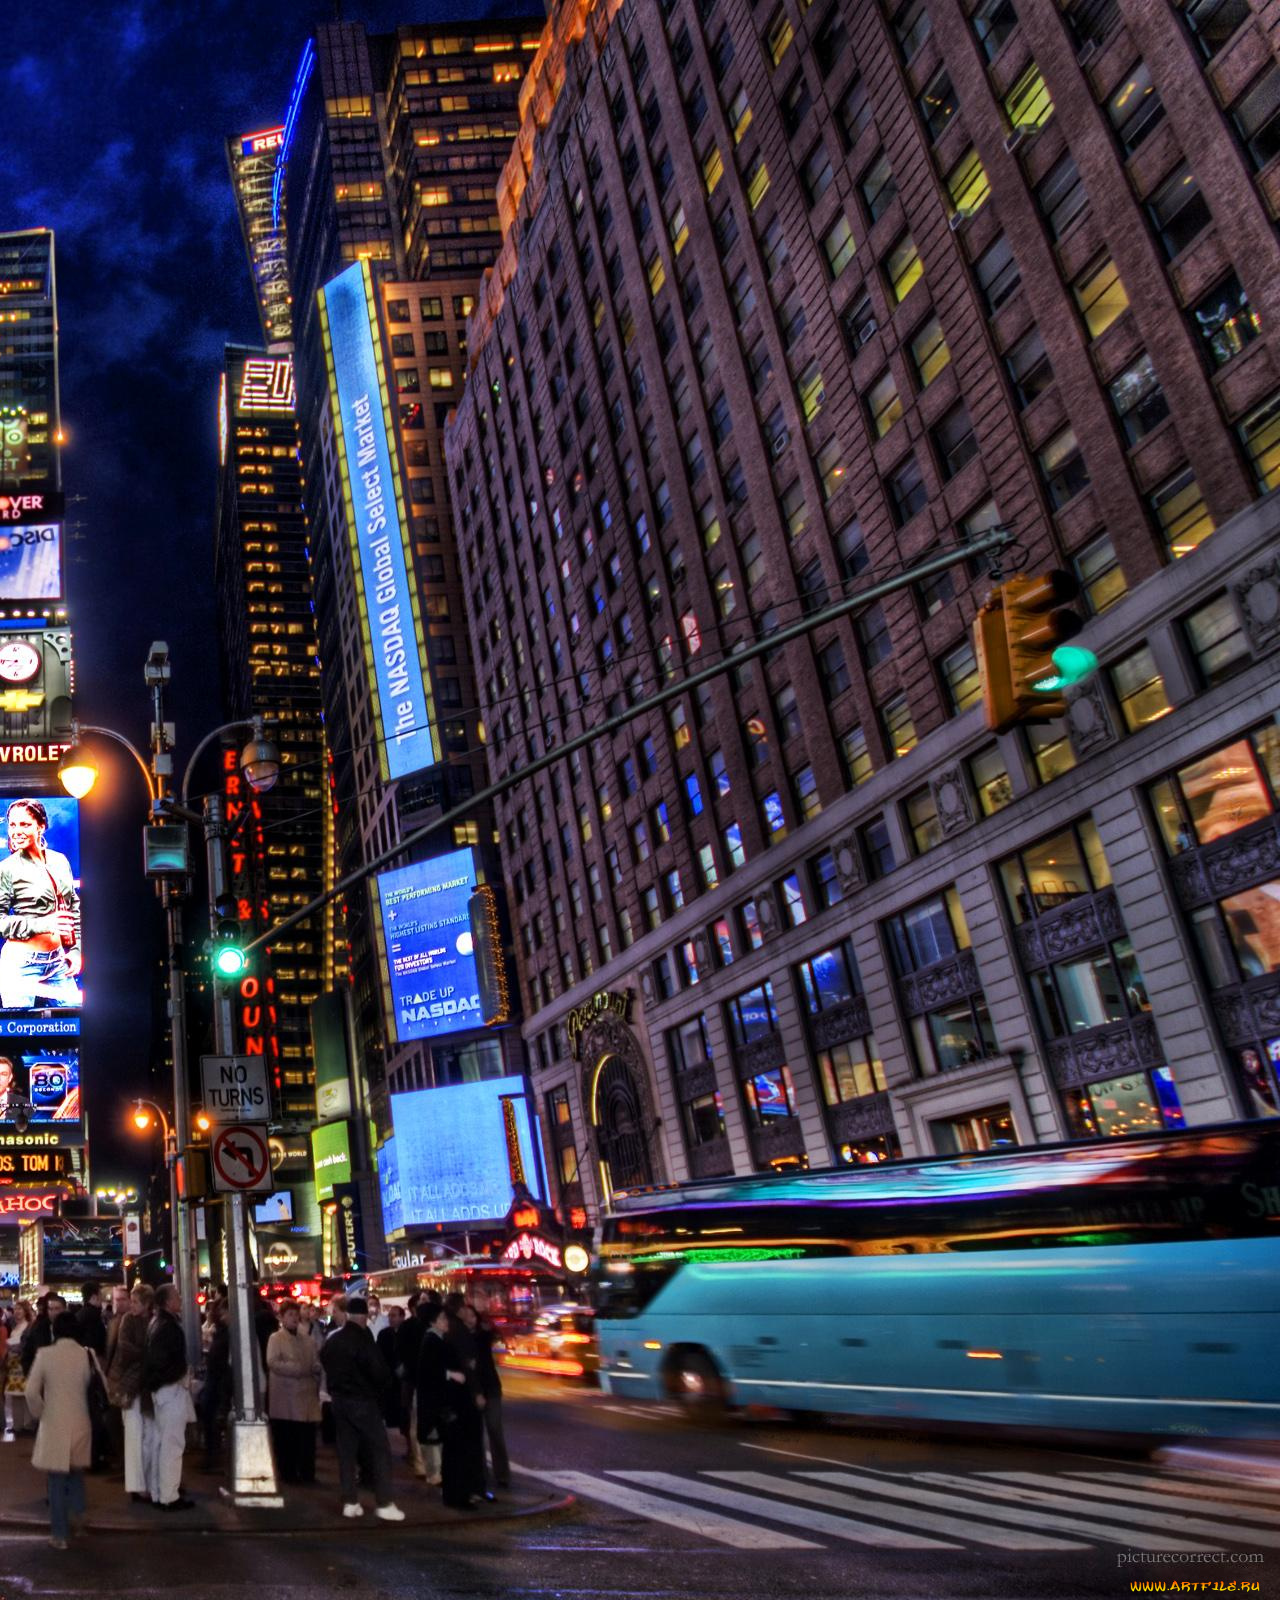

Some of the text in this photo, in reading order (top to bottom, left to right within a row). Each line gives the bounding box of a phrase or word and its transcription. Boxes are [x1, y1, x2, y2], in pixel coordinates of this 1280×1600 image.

[351, 393, 417, 746] The NASDAQ Global Select Market
[385, 875, 470, 906] BEST PERFORMING MARKET
[438, 986, 455, 997] UP
[7, 1020, 77, 1036] Corporation
[221, 1064, 247, 1084] NO
[209, 1086, 265, 1106] TURNS
[21, 1154, 49, 1172] TOM
